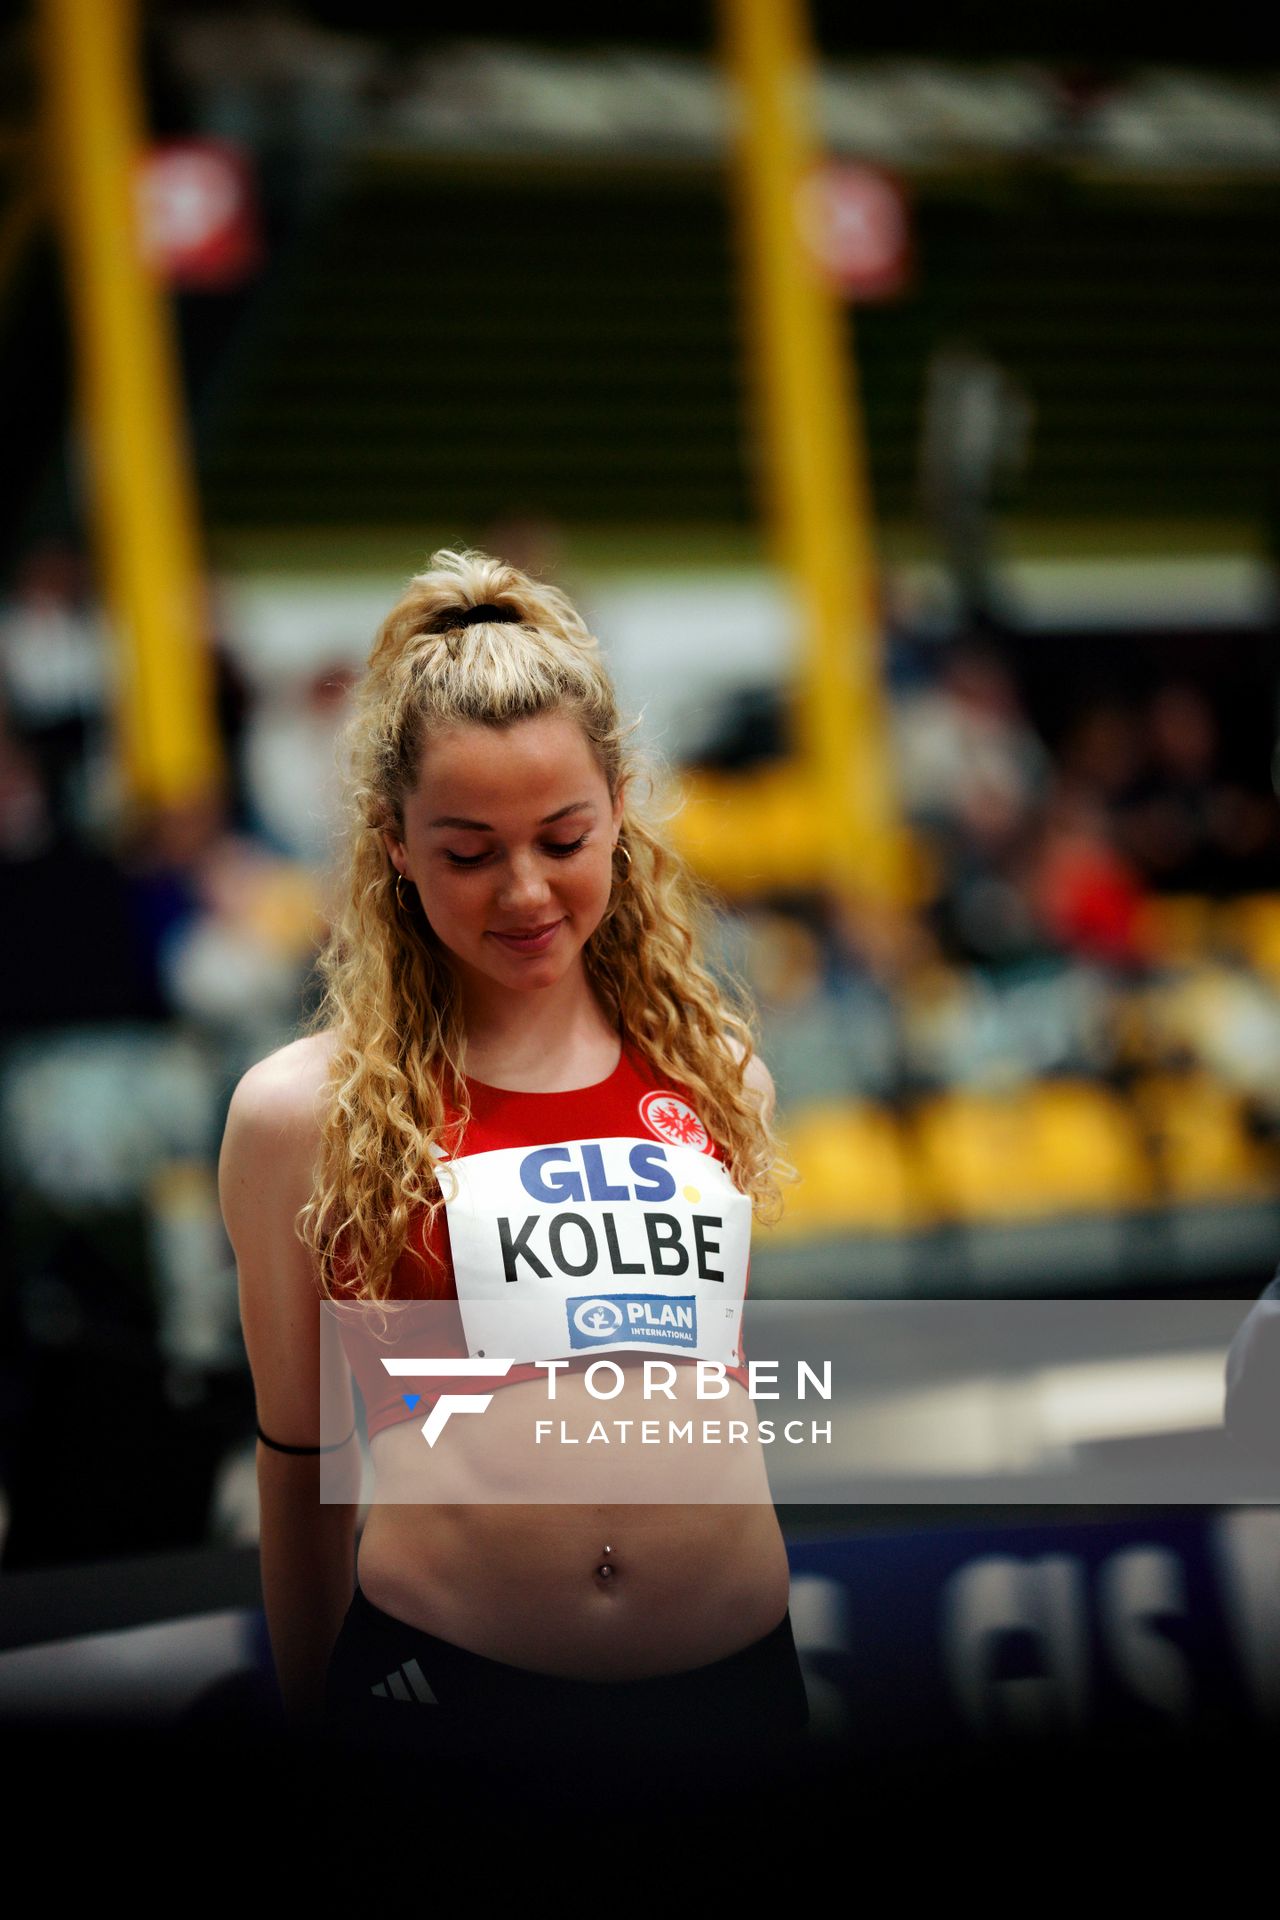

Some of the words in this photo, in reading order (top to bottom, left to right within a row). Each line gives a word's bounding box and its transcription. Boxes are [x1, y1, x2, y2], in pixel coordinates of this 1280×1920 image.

[497, 1212, 724, 1283] KOLBE
[626, 1303, 693, 1329] PLAN
[631, 1327, 693, 1341] INTERNATIONAL
